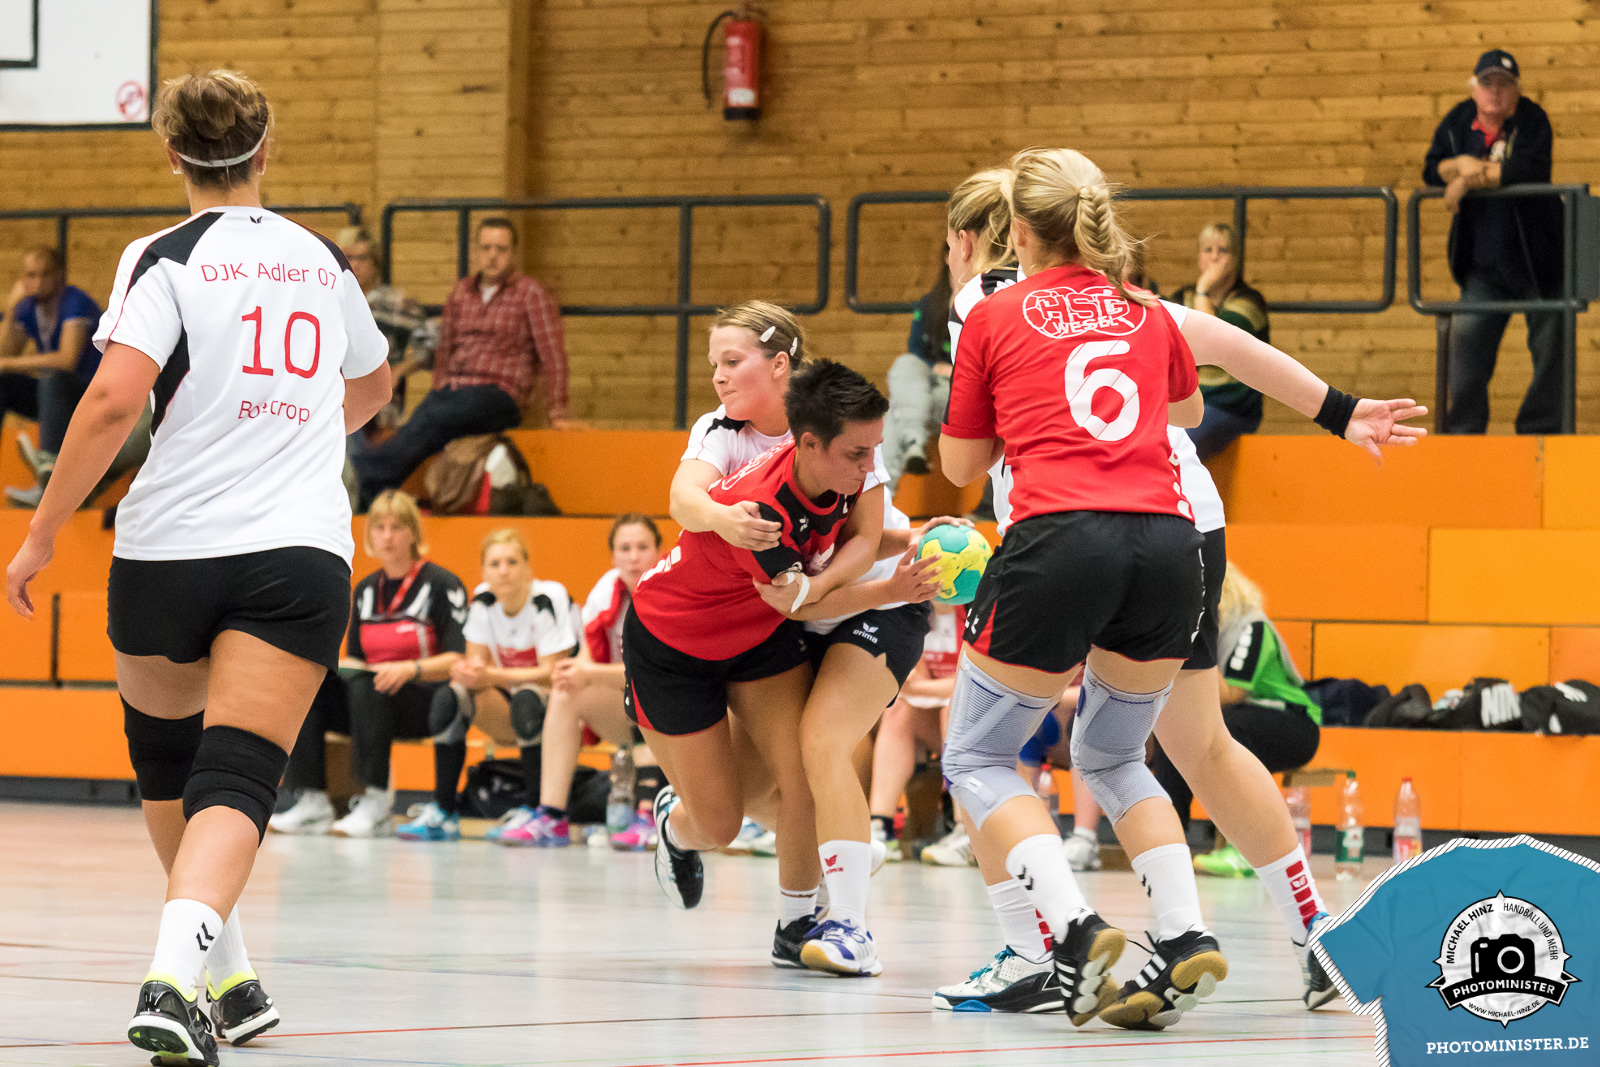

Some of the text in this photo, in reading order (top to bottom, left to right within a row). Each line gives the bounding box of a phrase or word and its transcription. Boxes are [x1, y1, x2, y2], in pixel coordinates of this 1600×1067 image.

[201, 262, 337, 290] DJK Adler 07
[1052, 315, 1120, 334] WESEL
[241, 305, 321, 379] 10
[1064, 339, 1140, 442] 6
[852, 629, 879, 645] erima
